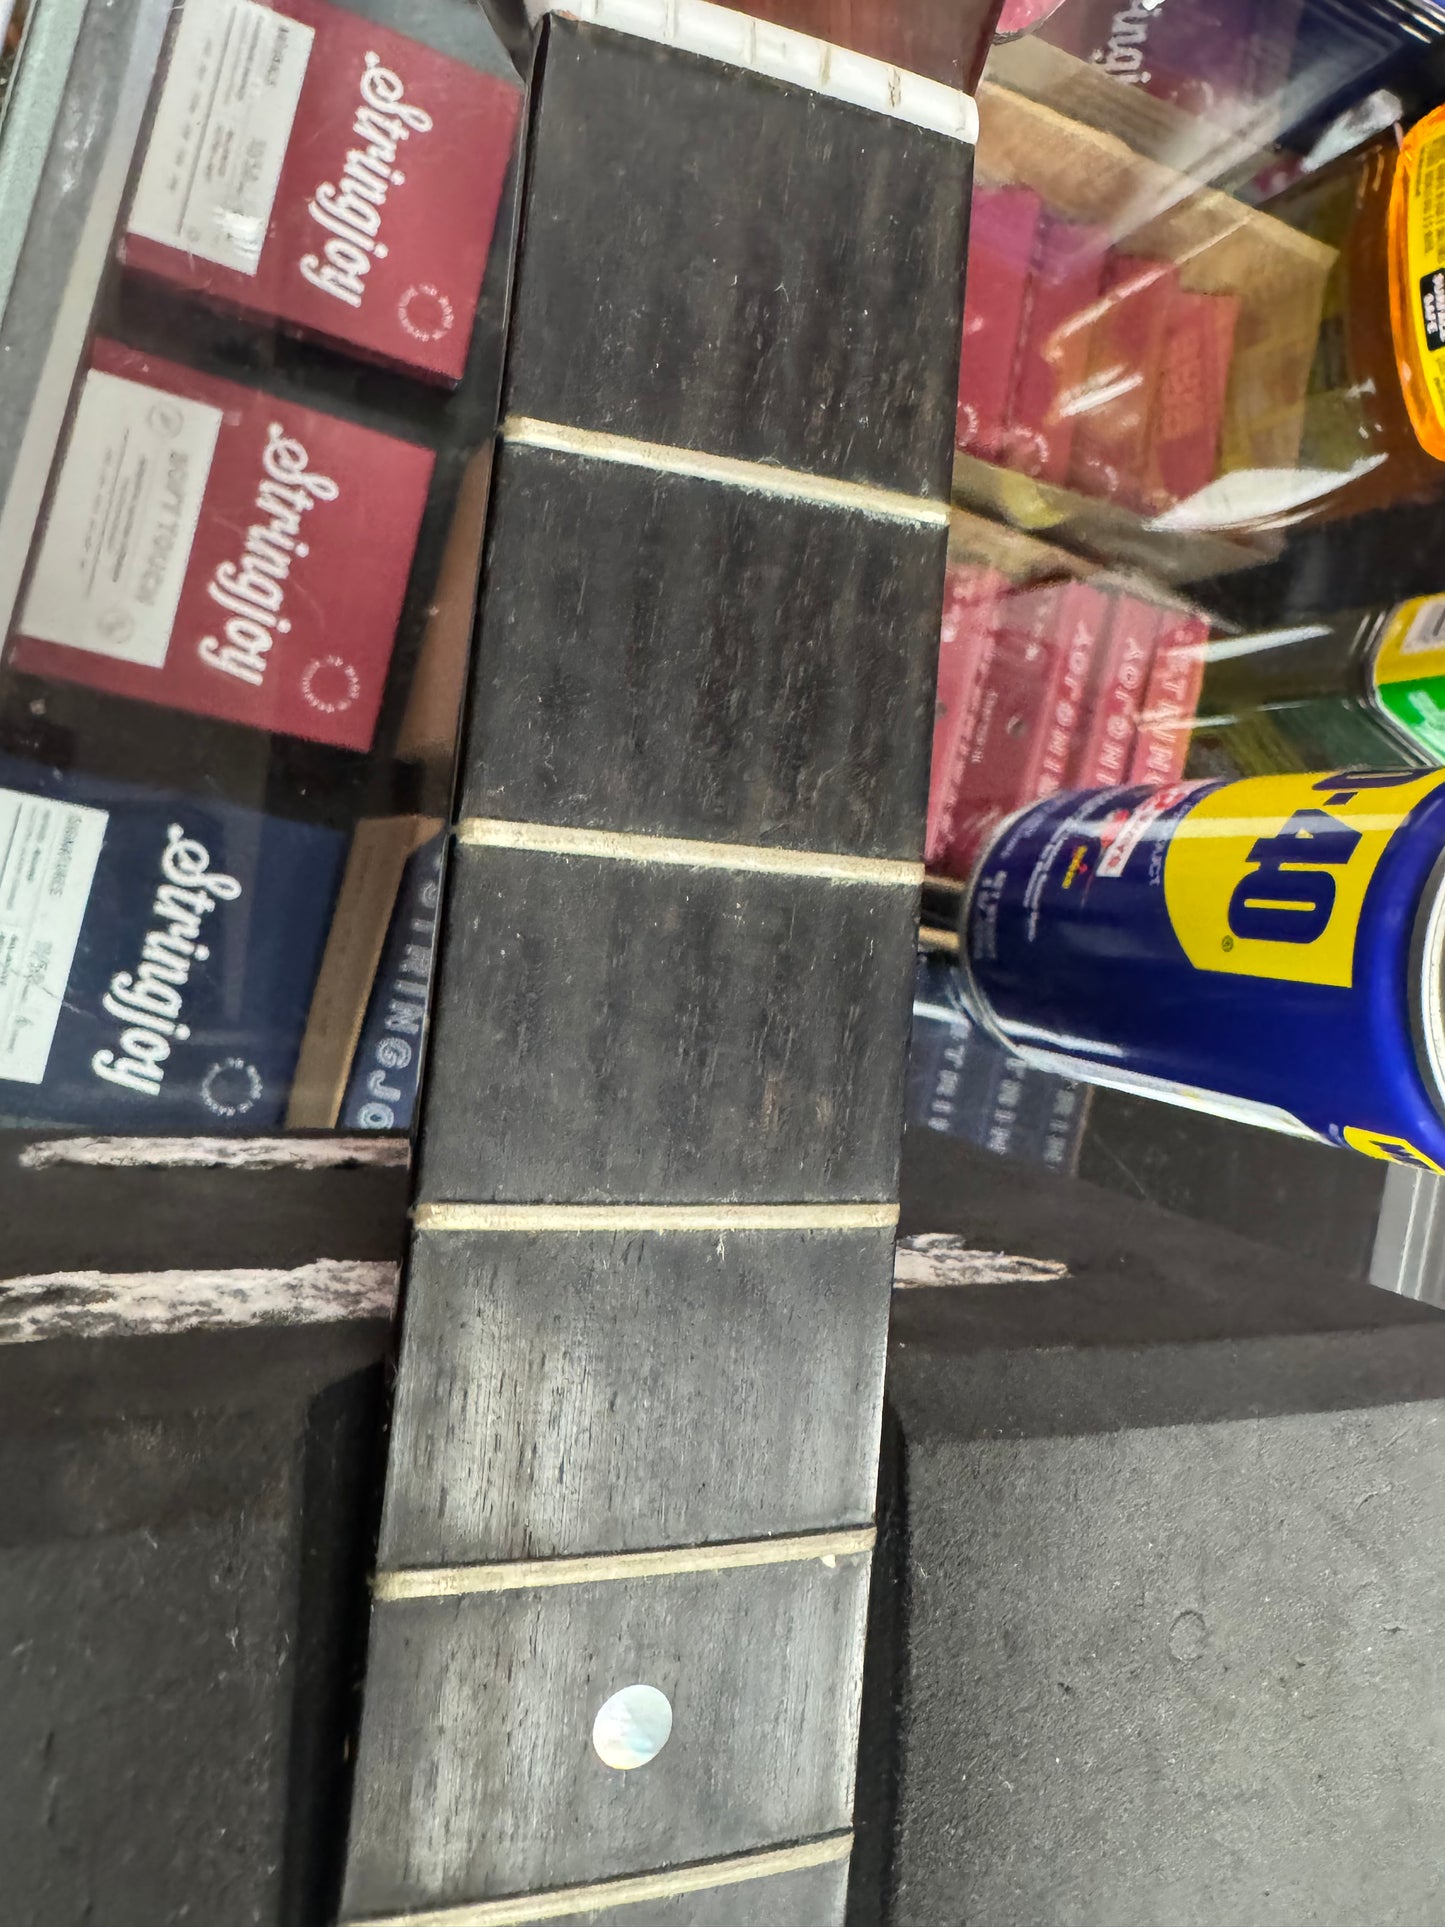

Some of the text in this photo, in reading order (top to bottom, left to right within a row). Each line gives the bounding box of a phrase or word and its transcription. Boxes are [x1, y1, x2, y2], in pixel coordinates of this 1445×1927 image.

[300, 51, 432, 308] Stringjoy
[197, 423, 338, 686] Stringjoy
[91, 823, 242, 1095] Stringjoy
